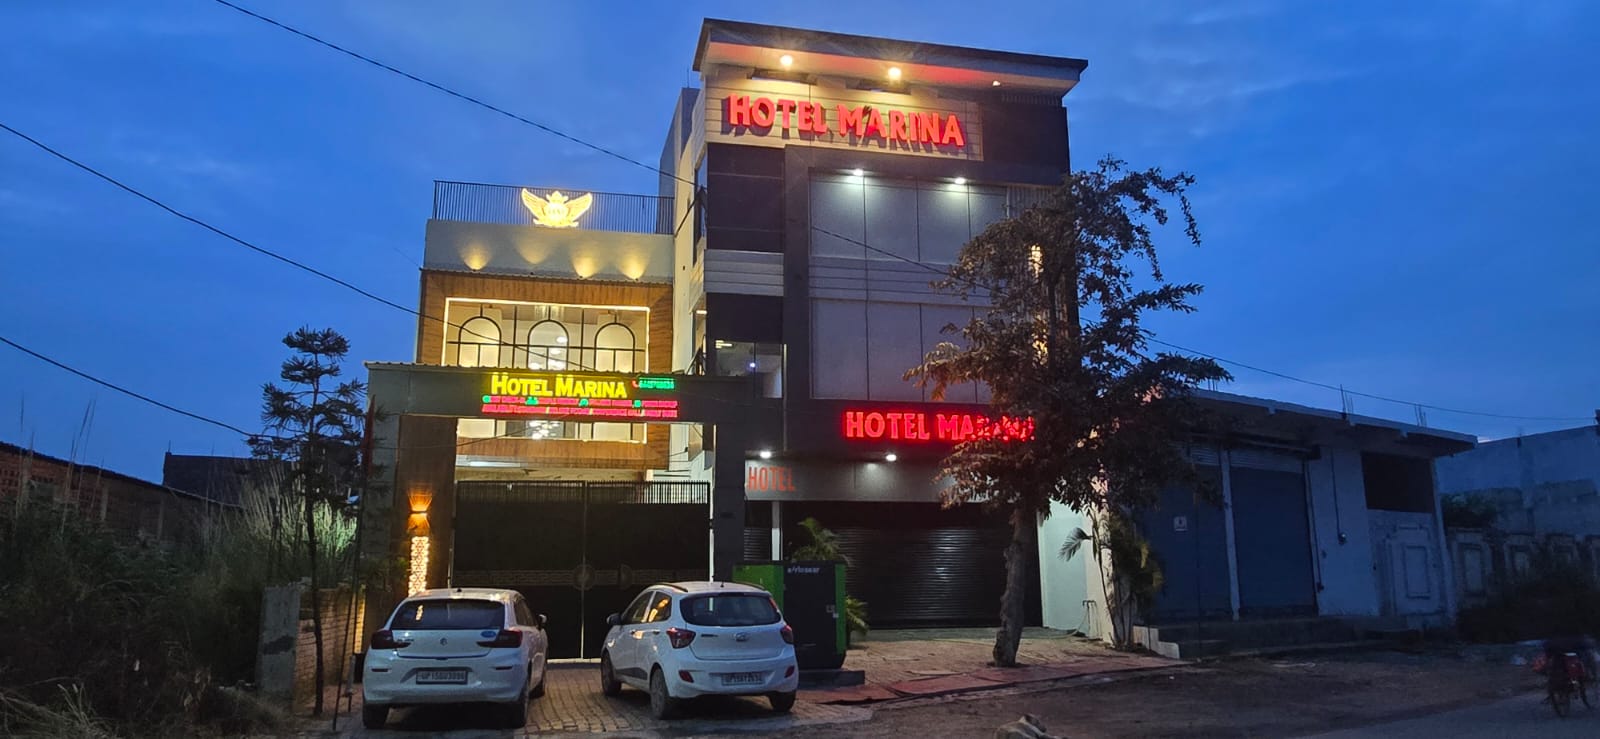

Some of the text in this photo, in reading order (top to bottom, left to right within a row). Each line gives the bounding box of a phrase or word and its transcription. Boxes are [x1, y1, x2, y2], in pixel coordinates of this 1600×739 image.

[728, 93, 965, 147] HOTEL MARINA
[490, 373, 553, 397] HOTEL
[555, 374, 628, 398] MARINA
[846, 411, 930, 440] HOTEL
[748, 466, 796, 494] HOTEL
